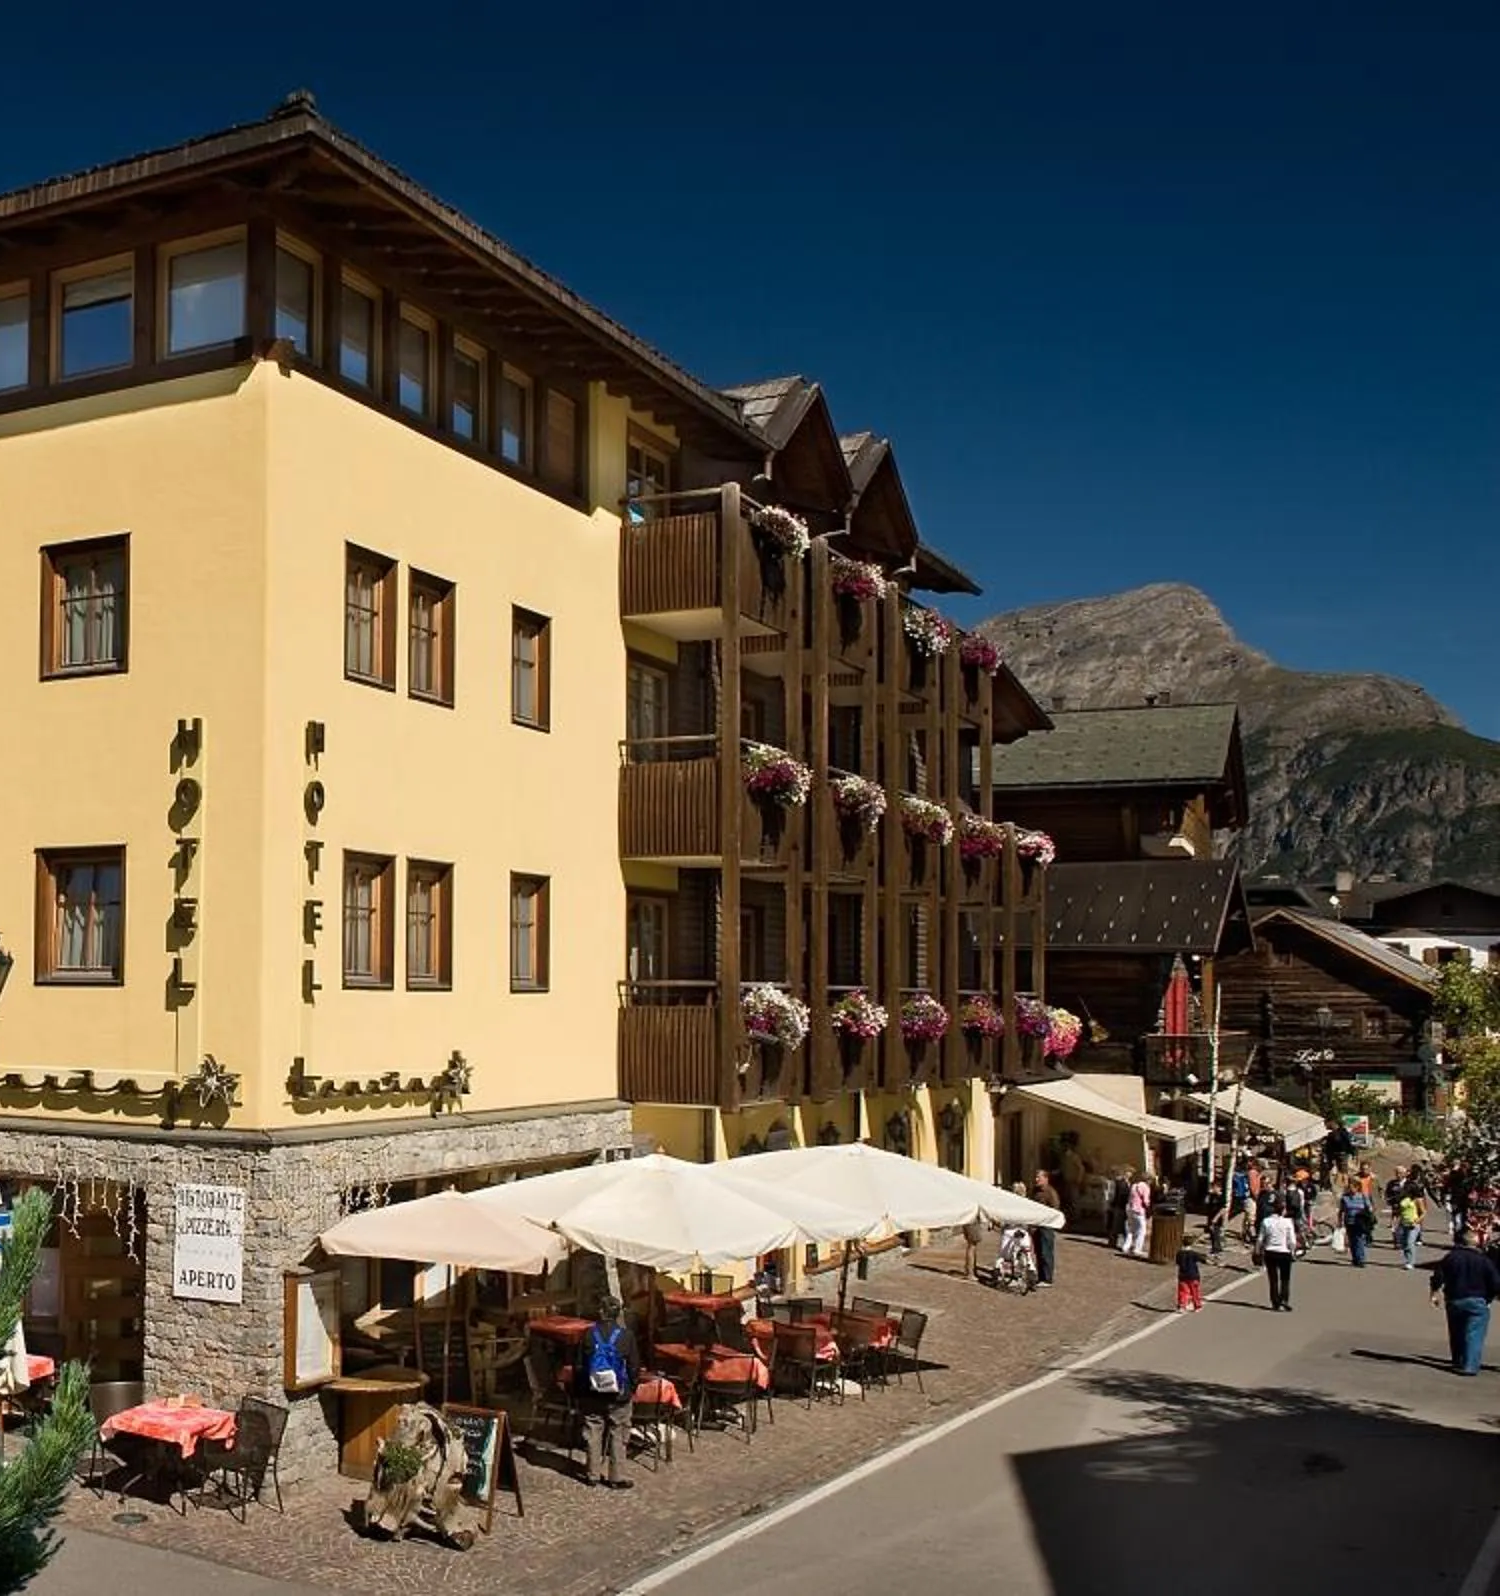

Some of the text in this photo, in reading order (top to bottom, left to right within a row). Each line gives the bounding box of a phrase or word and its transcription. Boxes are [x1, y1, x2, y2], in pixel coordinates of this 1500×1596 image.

[172, 717, 202, 990] HOTEL
[303, 720, 324, 992] HOTEL
[179, 1268, 236, 1292] APERTO
